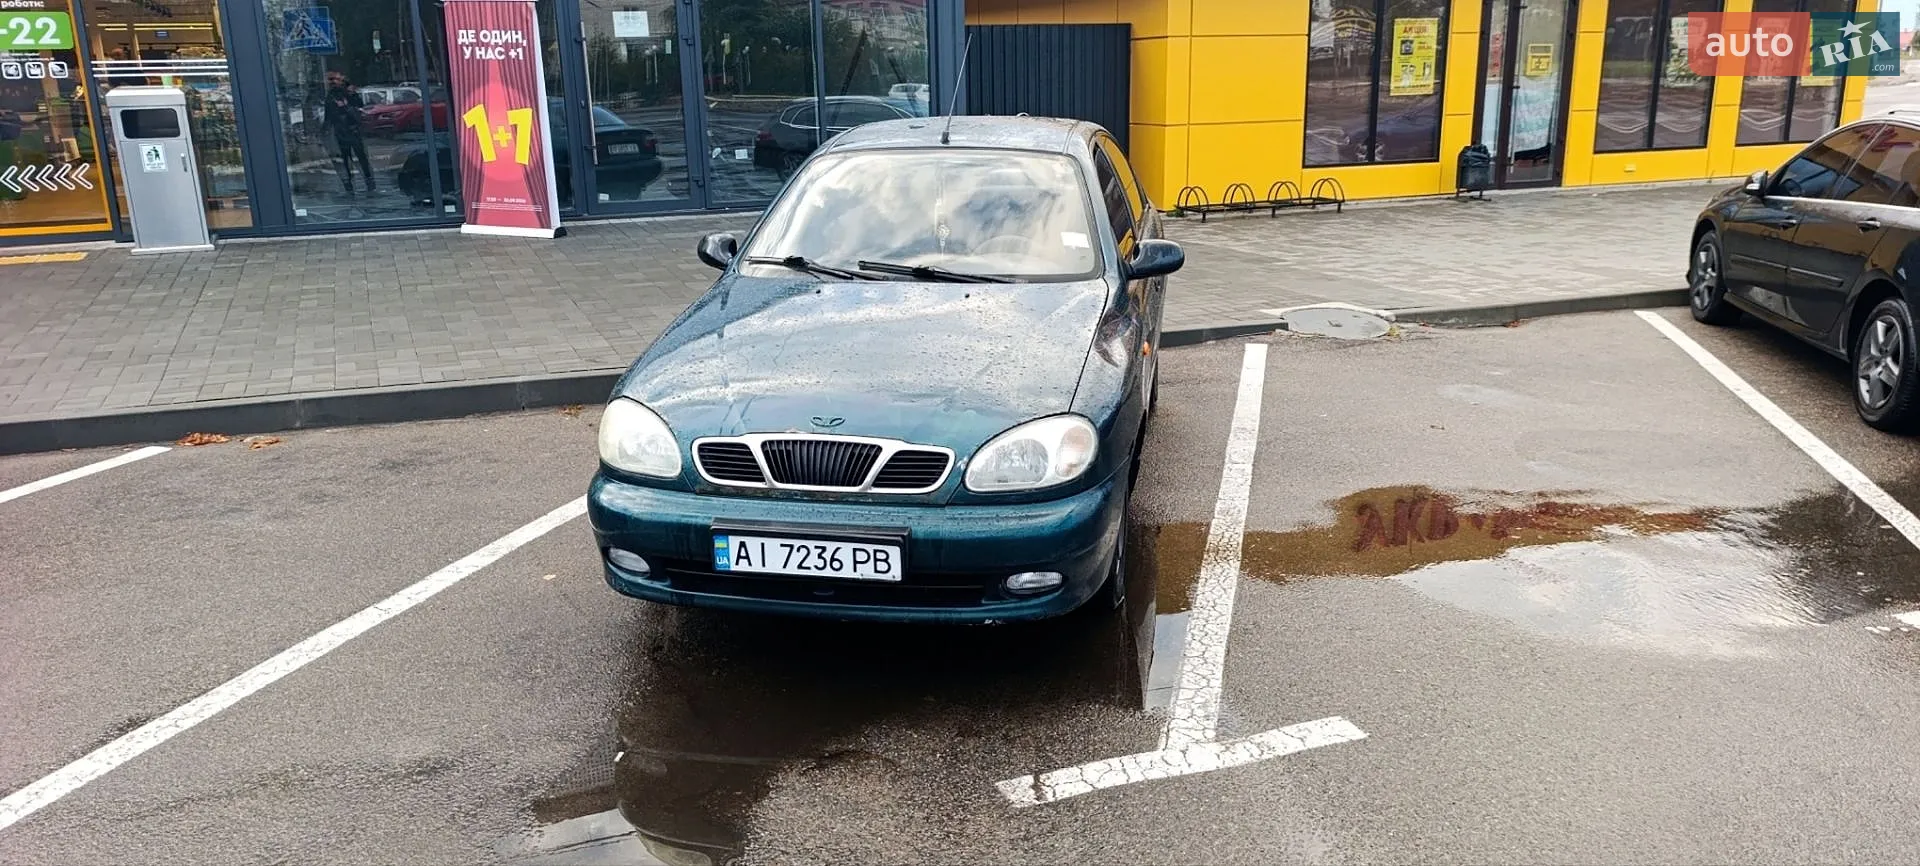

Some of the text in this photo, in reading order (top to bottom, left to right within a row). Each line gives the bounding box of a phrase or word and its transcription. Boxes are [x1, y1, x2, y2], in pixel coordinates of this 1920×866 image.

[457, 29, 527, 46] ДЕ ОДИН,
[463, 46, 524, 60] У НАС +1
[716, 556, 729, 565] UA
[779, 543, 844, 572] 7236
